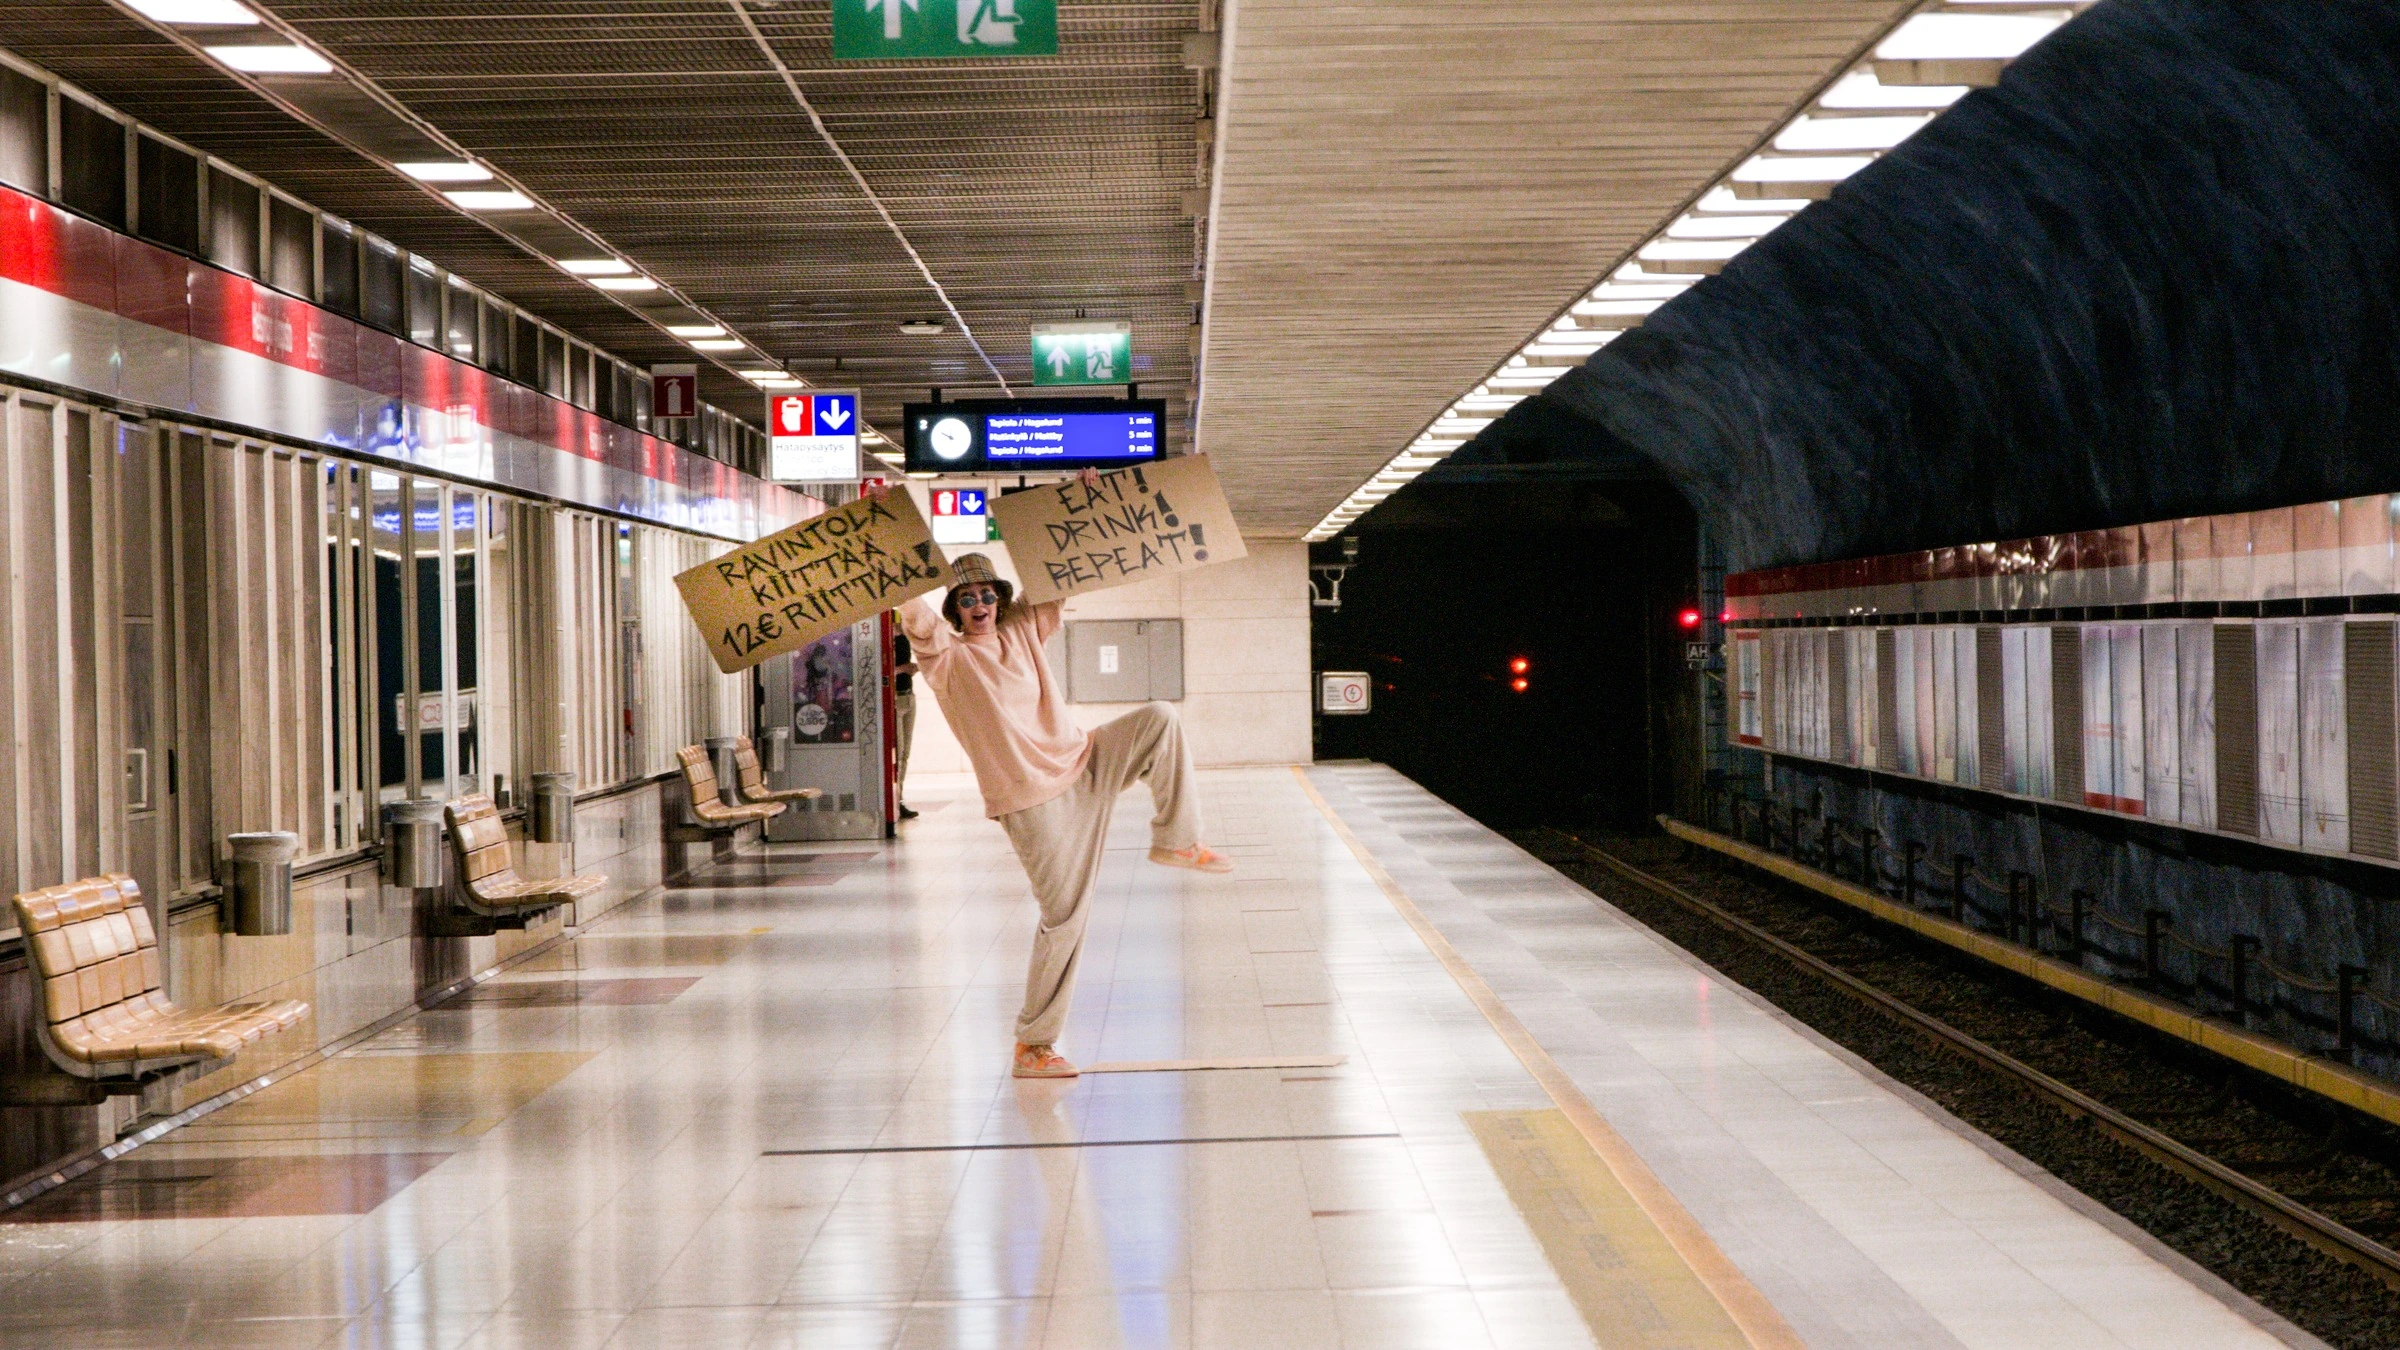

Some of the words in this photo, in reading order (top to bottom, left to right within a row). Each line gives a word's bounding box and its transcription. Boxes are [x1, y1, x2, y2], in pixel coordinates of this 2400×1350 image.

[919, 419, 928, 430] 2
[1128, 416, 1135, 425] 1
[1135, 416, 1153, 425] min
[1128, 430, 1136, 439] 5
[1135, 430, 1153, 439] min
[1136, 444, 1153, 453] min
[1056, 466, 1149, 515] EAT!
[716, 500, 898, 588] RAVINTOLA
[1045, 490, 1180, 554] DRINK!
[751, 533, 886, 607] KIITTÄÄ
[1043, 523, 1209, 590] REPEAT!
[722, 613, 783, 657] 12€
